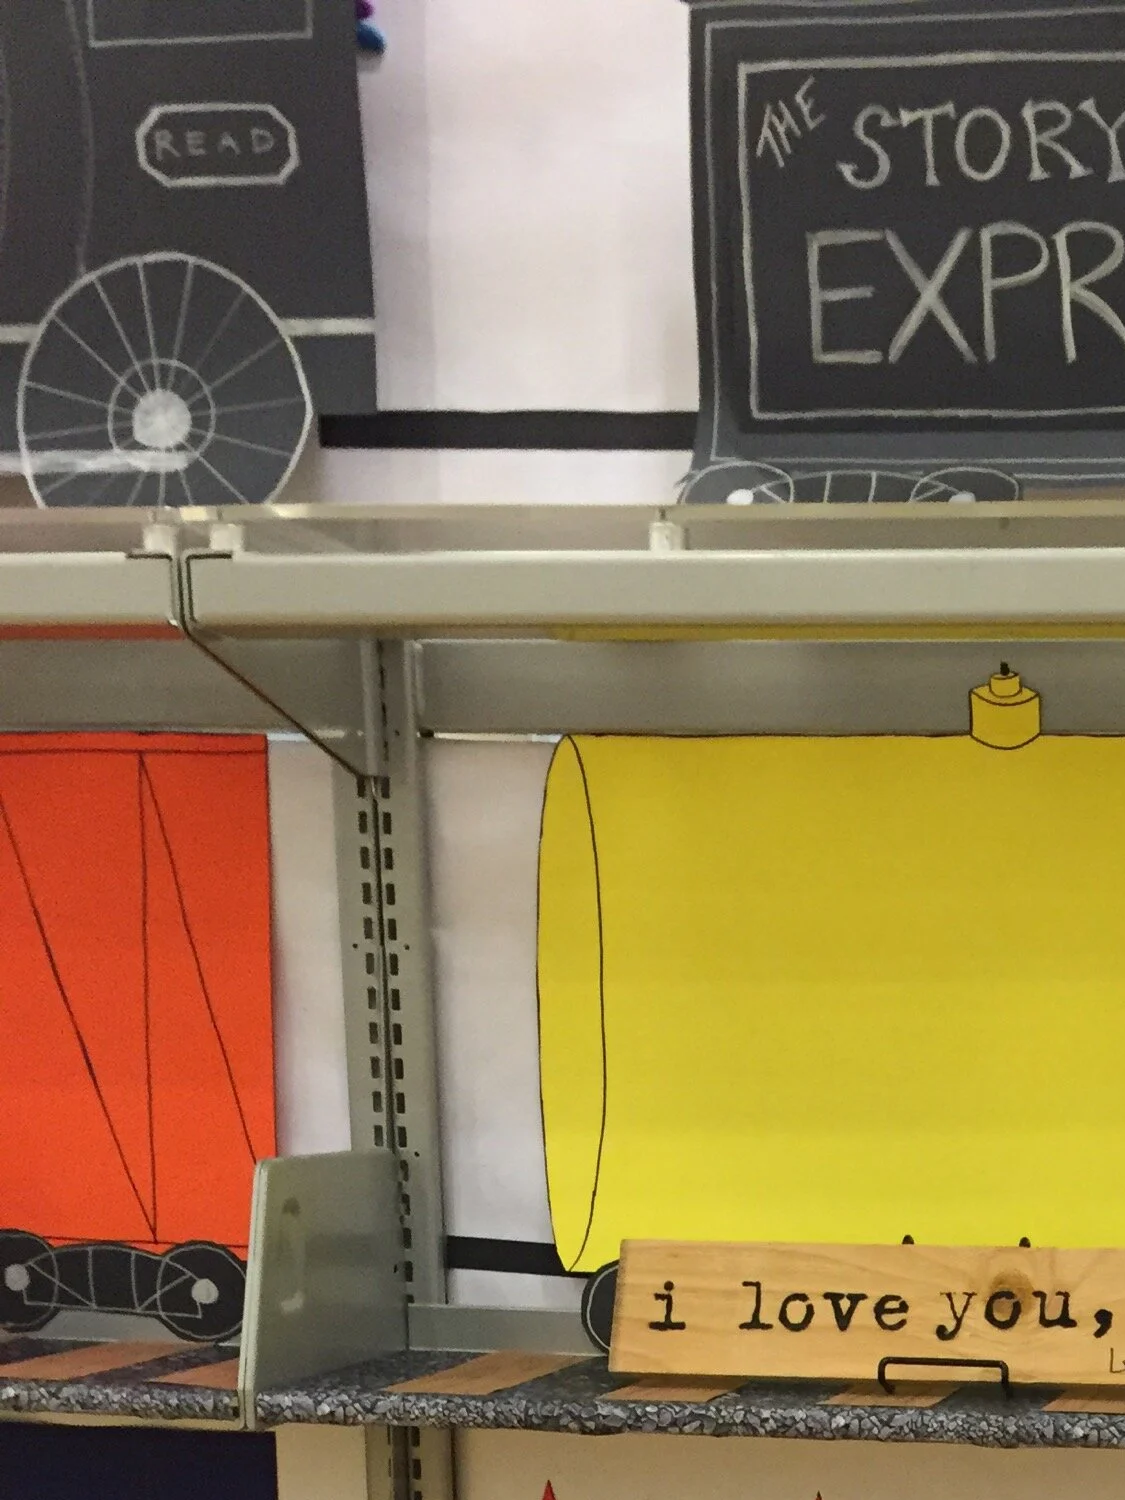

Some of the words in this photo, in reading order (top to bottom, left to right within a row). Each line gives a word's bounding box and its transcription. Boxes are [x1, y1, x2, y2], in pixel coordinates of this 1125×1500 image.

[154, 128, 274, 160] READ
[756, 75, 826, 168] THE
[649, 1281, 687, 1332] i
[738, 1281, 909, 1331] love
[935, 1290, 1114, 1341] you,
